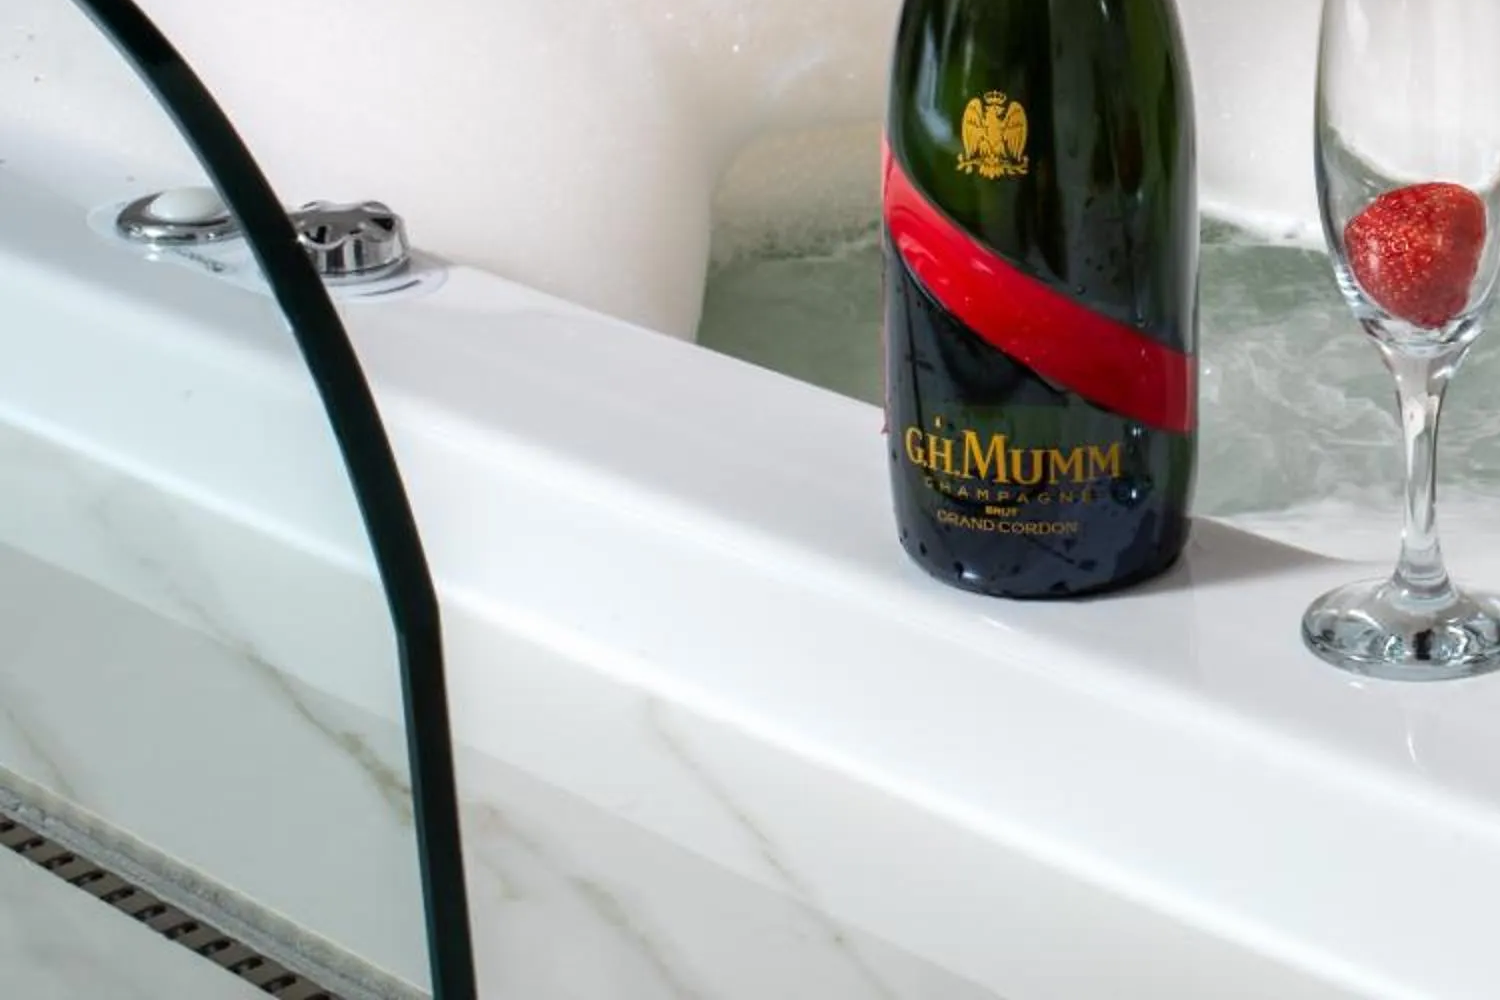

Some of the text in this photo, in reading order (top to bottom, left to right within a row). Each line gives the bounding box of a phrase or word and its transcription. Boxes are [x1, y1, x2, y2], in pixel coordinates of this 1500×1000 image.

[924, 477, 1093, 504] CHAMPAGNE
[937, 509, 1079, 536] GRAND CORDON
[984, 505, 1019, 517] BRUT
